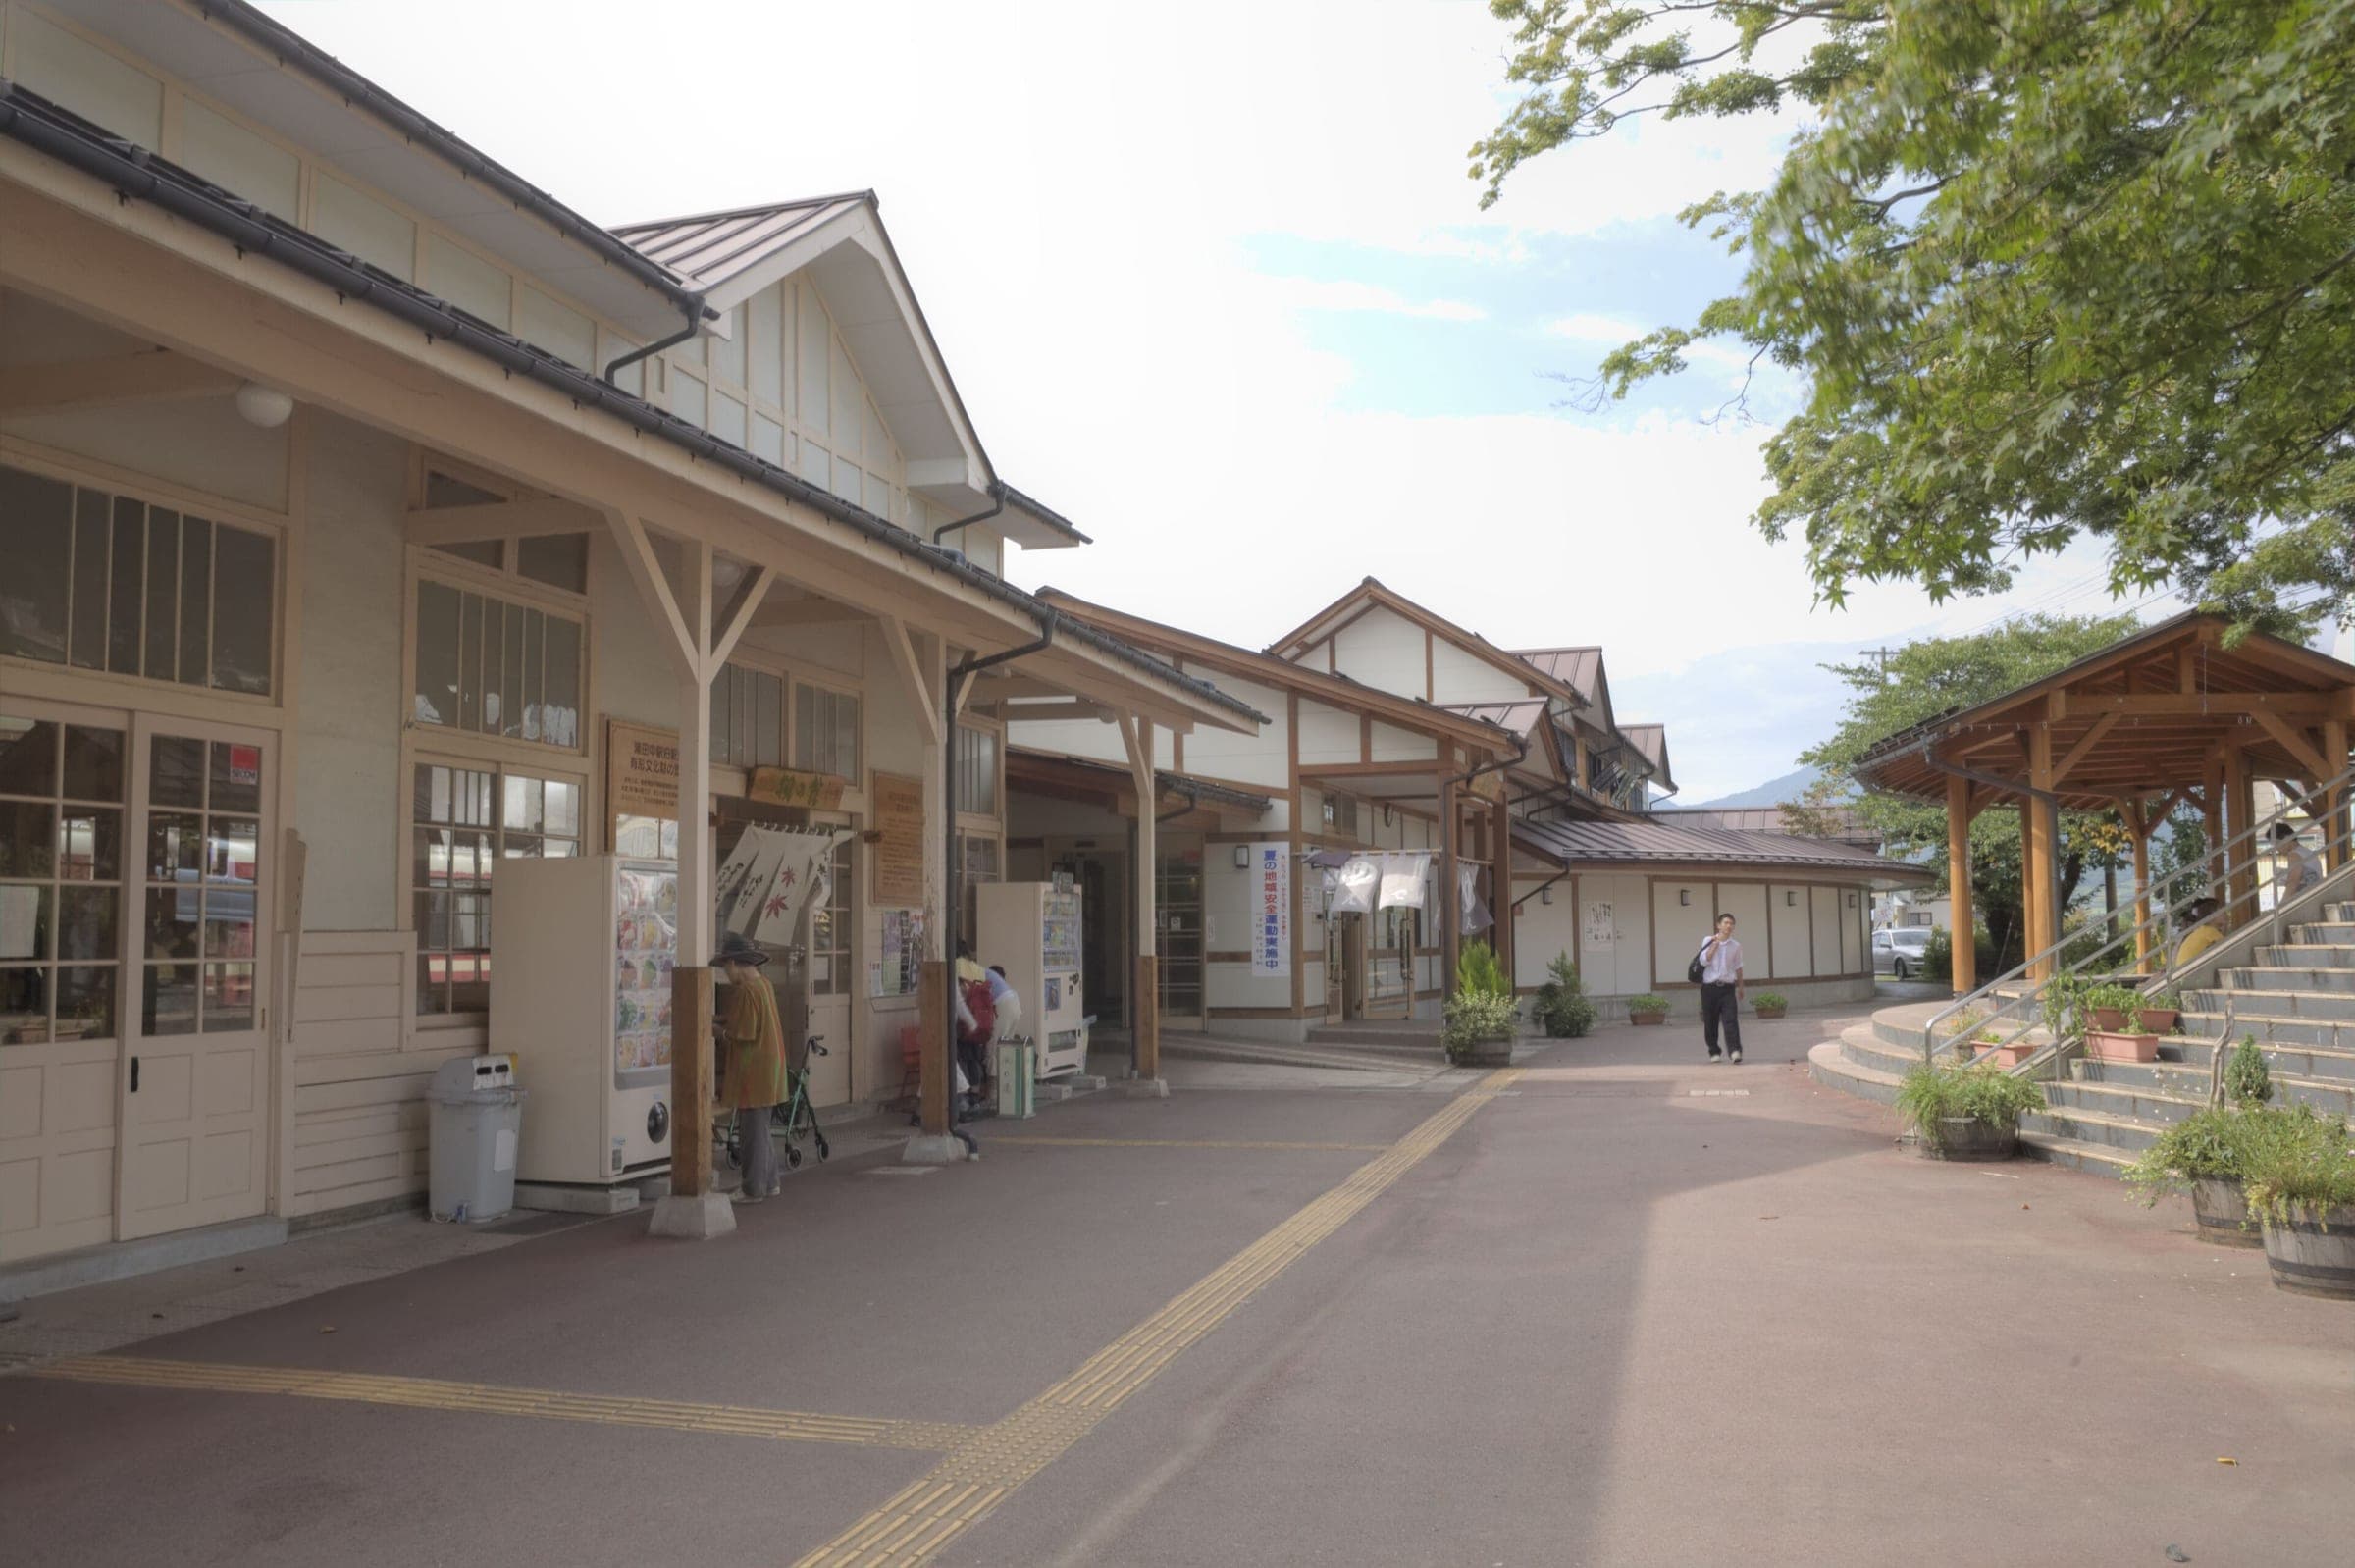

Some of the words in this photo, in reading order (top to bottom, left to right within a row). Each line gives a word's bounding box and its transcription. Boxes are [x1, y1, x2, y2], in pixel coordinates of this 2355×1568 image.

[1264, 850, 1278, 969] 夏の地域安全運動実施中
